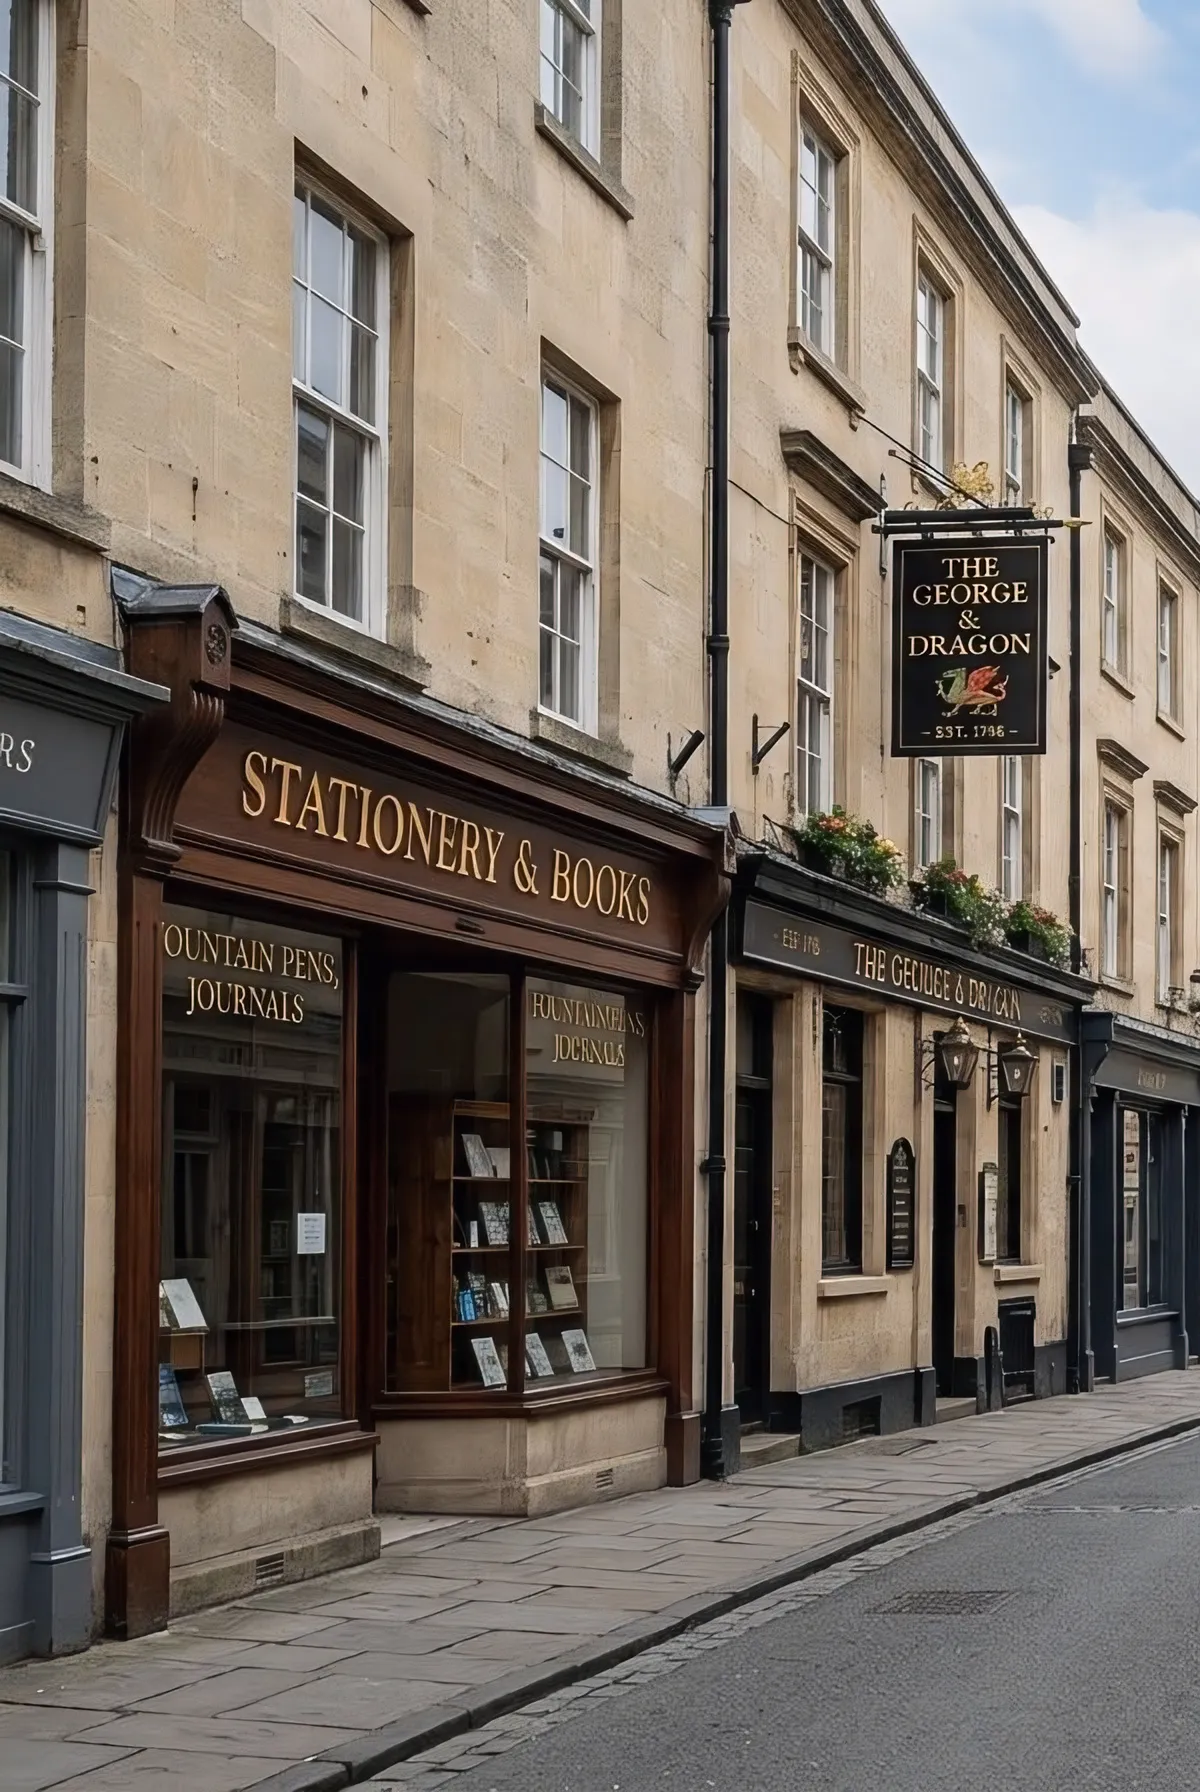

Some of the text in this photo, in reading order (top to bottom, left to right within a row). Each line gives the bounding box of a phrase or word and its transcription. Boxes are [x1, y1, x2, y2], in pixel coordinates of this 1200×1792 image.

[941, 556, 1000, 579] THE
[912, 581, 1029, 606] GEORGE
[958, 609, 981, 630] &
[907, 633, 1031, 657] DRAGON
[241, 750, 652, 926] STATIONERY & BOOKS
[161, 921, 339, 990] OUNTAIN PENS,
